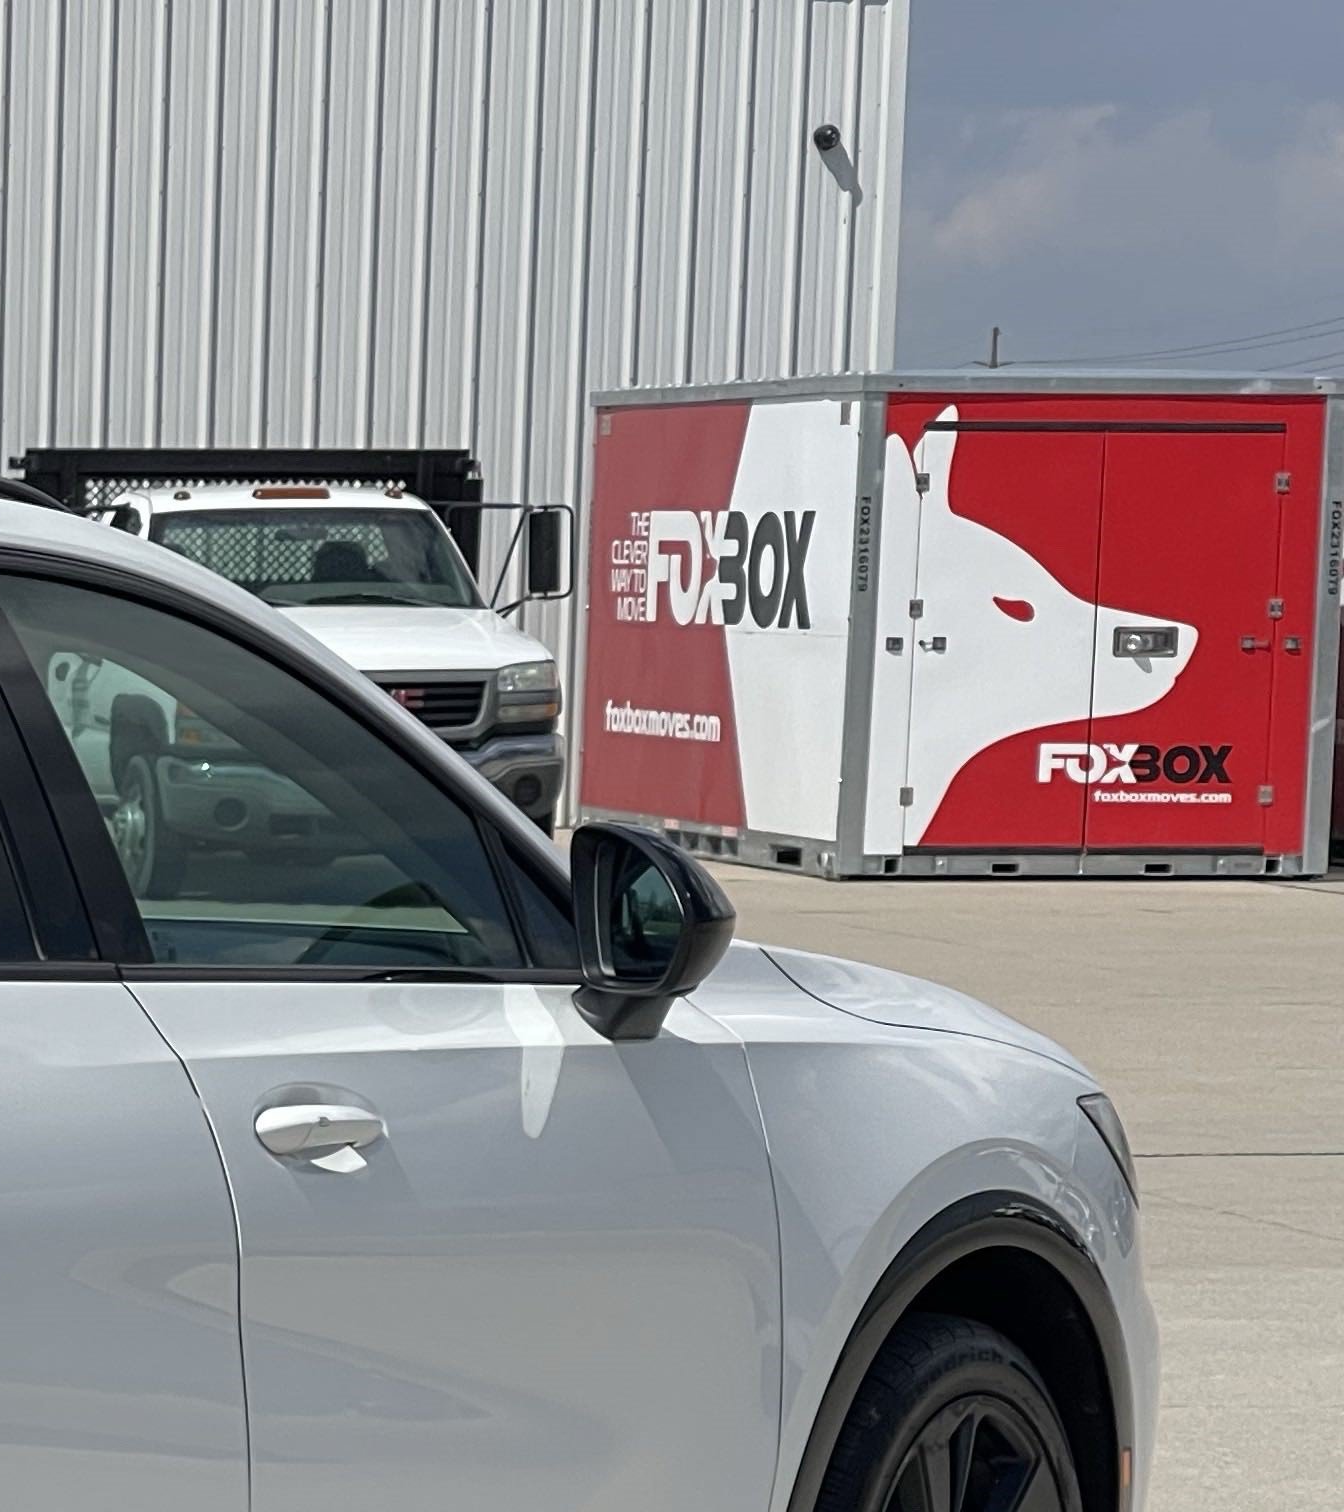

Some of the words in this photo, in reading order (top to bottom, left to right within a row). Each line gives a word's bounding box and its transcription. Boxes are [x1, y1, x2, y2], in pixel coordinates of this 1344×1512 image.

[631, 512, 649, 536] THE
[612, 540, 649, 565] CLEVER
[611, 569, 633, 592] WAY
[632, 569, 647, 594] TO
[645, 510, 817, 630] FOXBOX
[617, 597, 647, 621] MOVE
[605, 699, 721, 742] foxboxmoves.com
[1037, 743, 1233, 784] FOXBOX
[1094, 789, 1232, 803] foxboxmoves.com
